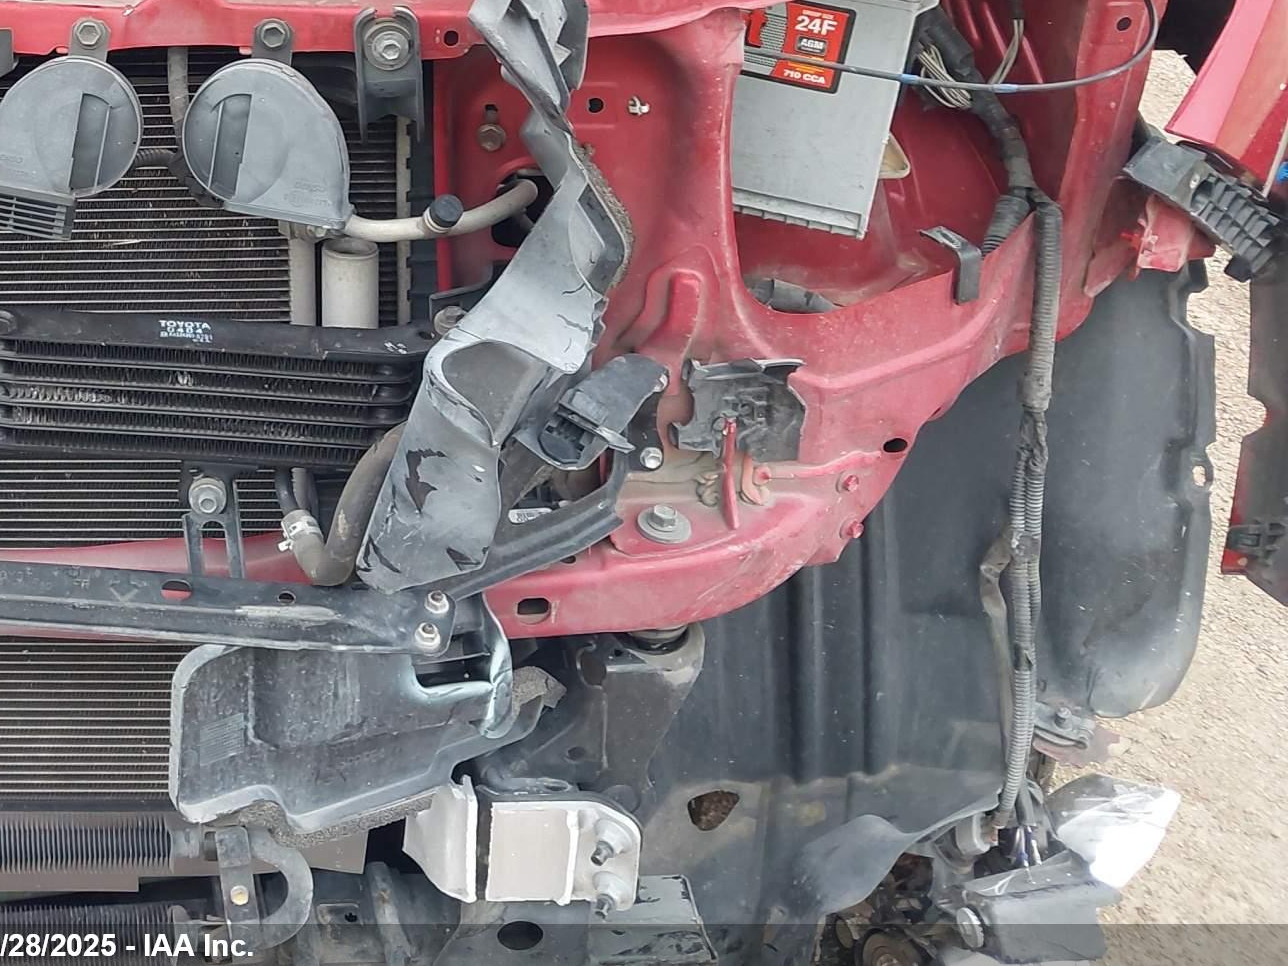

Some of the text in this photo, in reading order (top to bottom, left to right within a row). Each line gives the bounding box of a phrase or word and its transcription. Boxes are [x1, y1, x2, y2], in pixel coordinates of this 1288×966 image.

[795, 15, 838, 35] 24F
[783, 68, 826, 84] 710 CCA
[159, 320, 212, 330] TOYOTA
